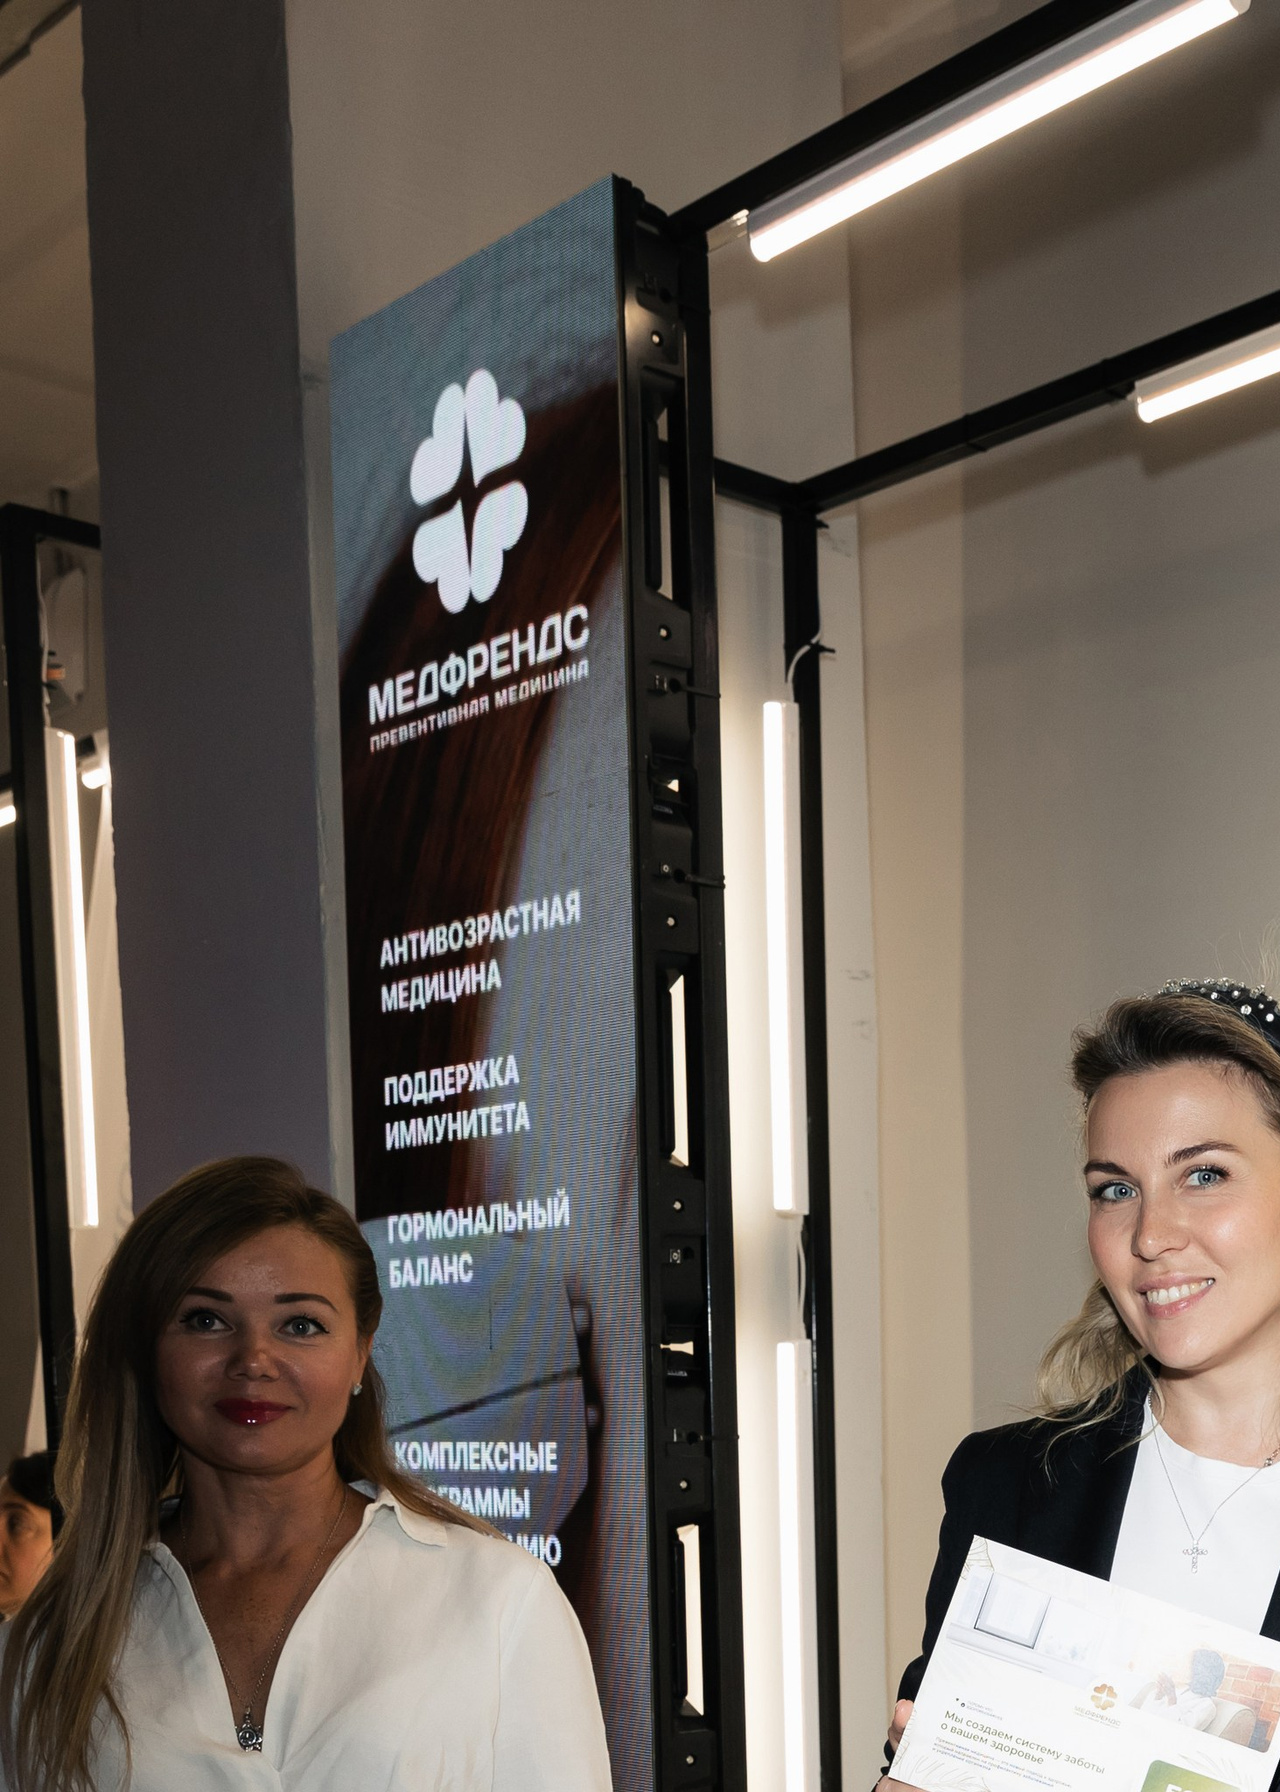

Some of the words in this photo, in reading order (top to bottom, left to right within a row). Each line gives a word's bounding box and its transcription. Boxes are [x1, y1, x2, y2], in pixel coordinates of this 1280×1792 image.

[368, 603, 590, 725] МЕДФРЕНДС
[370, 694, 490, 755] ПРЕВЕНТИВНАЯ
[495, 659, 590, 709] МЕДИЦИНА
[380, 889, 580, 969] АНТИВОЗРАСТНАЯ
[381, 958, 502, 1013] МЕДИЦИНА
[384, 1055, 520, 1106] ПОДДЕРЖКА
[385, 1101, 531, 1151] ИММУНИТЕТА
[387, 1188, 570, 1244] ГОРМОНАЛЬНЫЙ
[389, 1253, 473, 1289] БАЛАНС
[394, 1441, 558, 1472] КОМПЛЕКСНЫЕ
[940, 1722, 948, 1730] о
[950, 1725, 988, 1746] вашем
[990, 1740, 1044, 1765] здоровье
[944, 1710, 963, 1724] Мы
[965, 1718, 1013, 1742] создаем
[1015, 1735, 1063, 1760] систему
[1064, 1753, 1105, 1775] заботы
